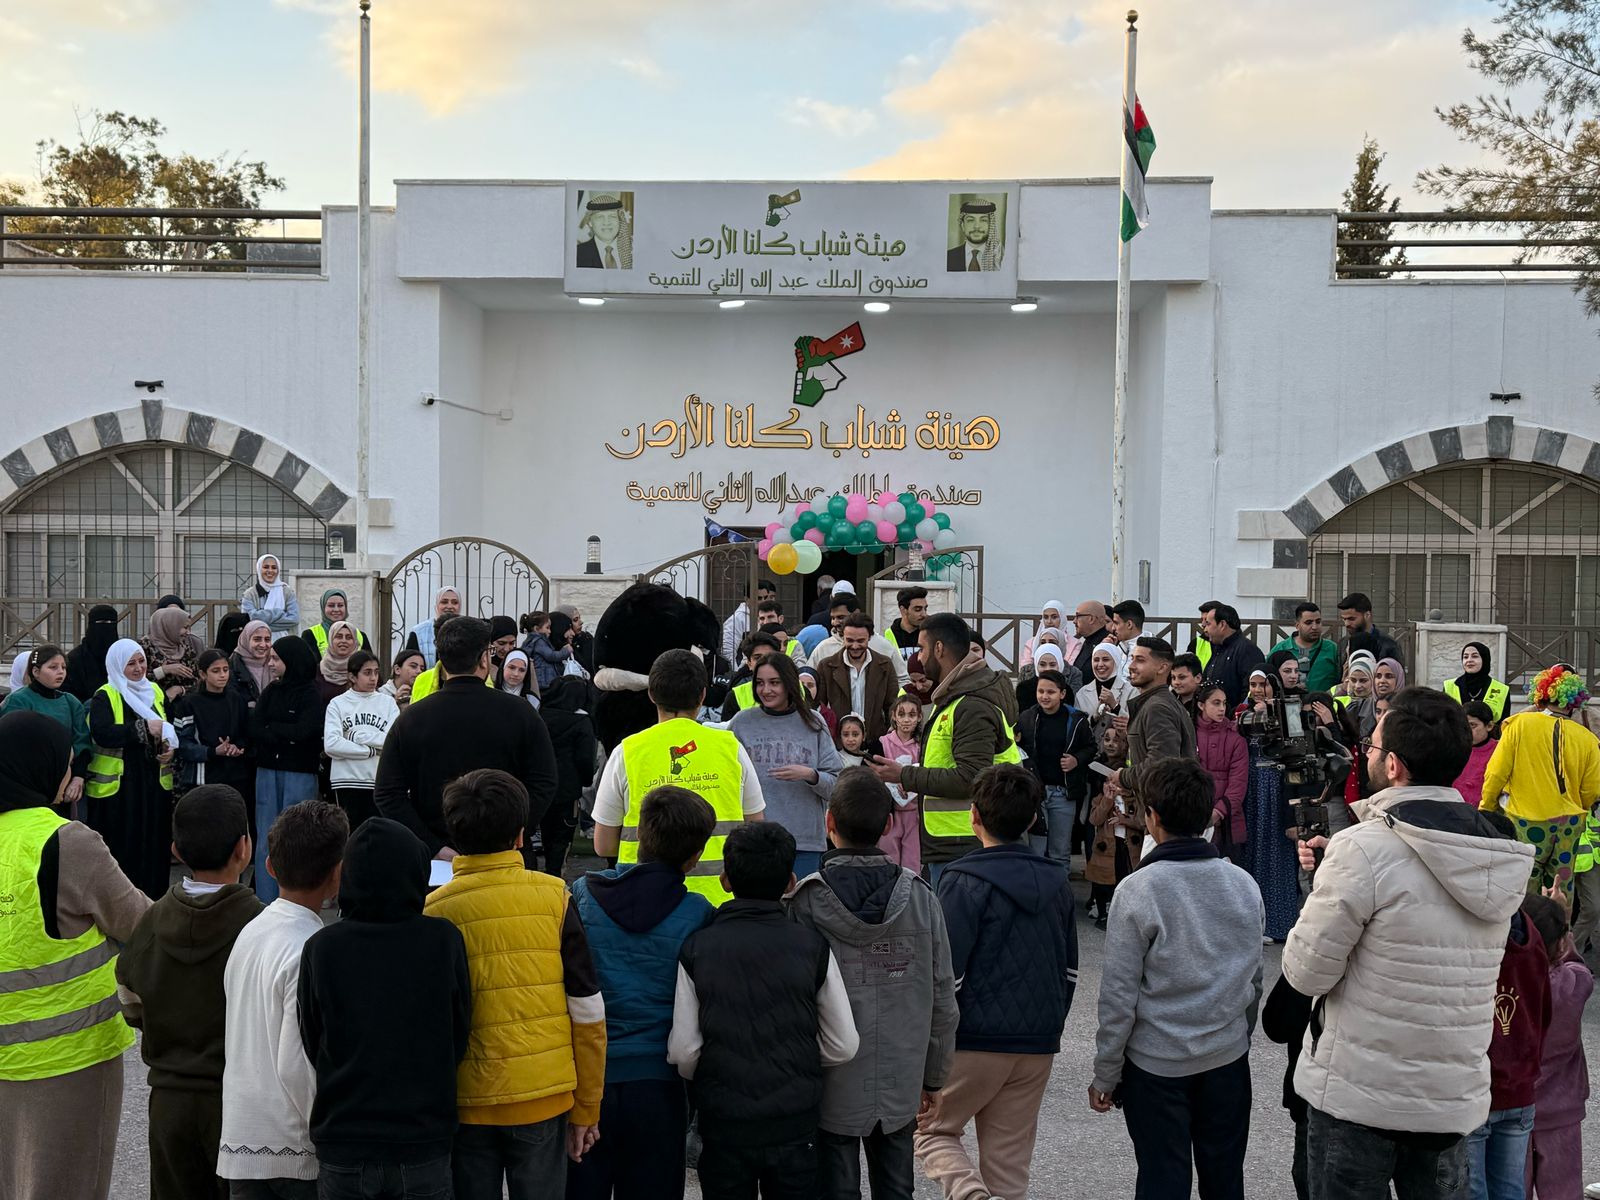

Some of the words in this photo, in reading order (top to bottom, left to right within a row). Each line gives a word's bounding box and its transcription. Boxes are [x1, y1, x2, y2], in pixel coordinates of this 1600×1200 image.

[671, 224, 737, 260] الأردن
[744, 227, 796, 256] كلنا
[800, 230, 851, 261] شباب
[855, 232, 906, 261] هيئة
[649, 267, 701, 287] للتنمية
[708, 268, 744, 295] الثاني
[751, 269, 772, 295] الله
[779, 275, 808, 290] عبد
[816, 269, 861, 294] الملك
[869, 275, 928, 295] صندوق
[605, 394, 715, 460] الأردن
[725, 402, 814, 450] كلنا
[819, 403, 907, 458] شباب
[915, 410, 1000, 460] هيئة
[626, 472, 702, 507] للتنمية
[702, 470, 753, 515] الثاني
[342, 717, 353, 732] OS
[354, 713, 388, 732] ANGELE
